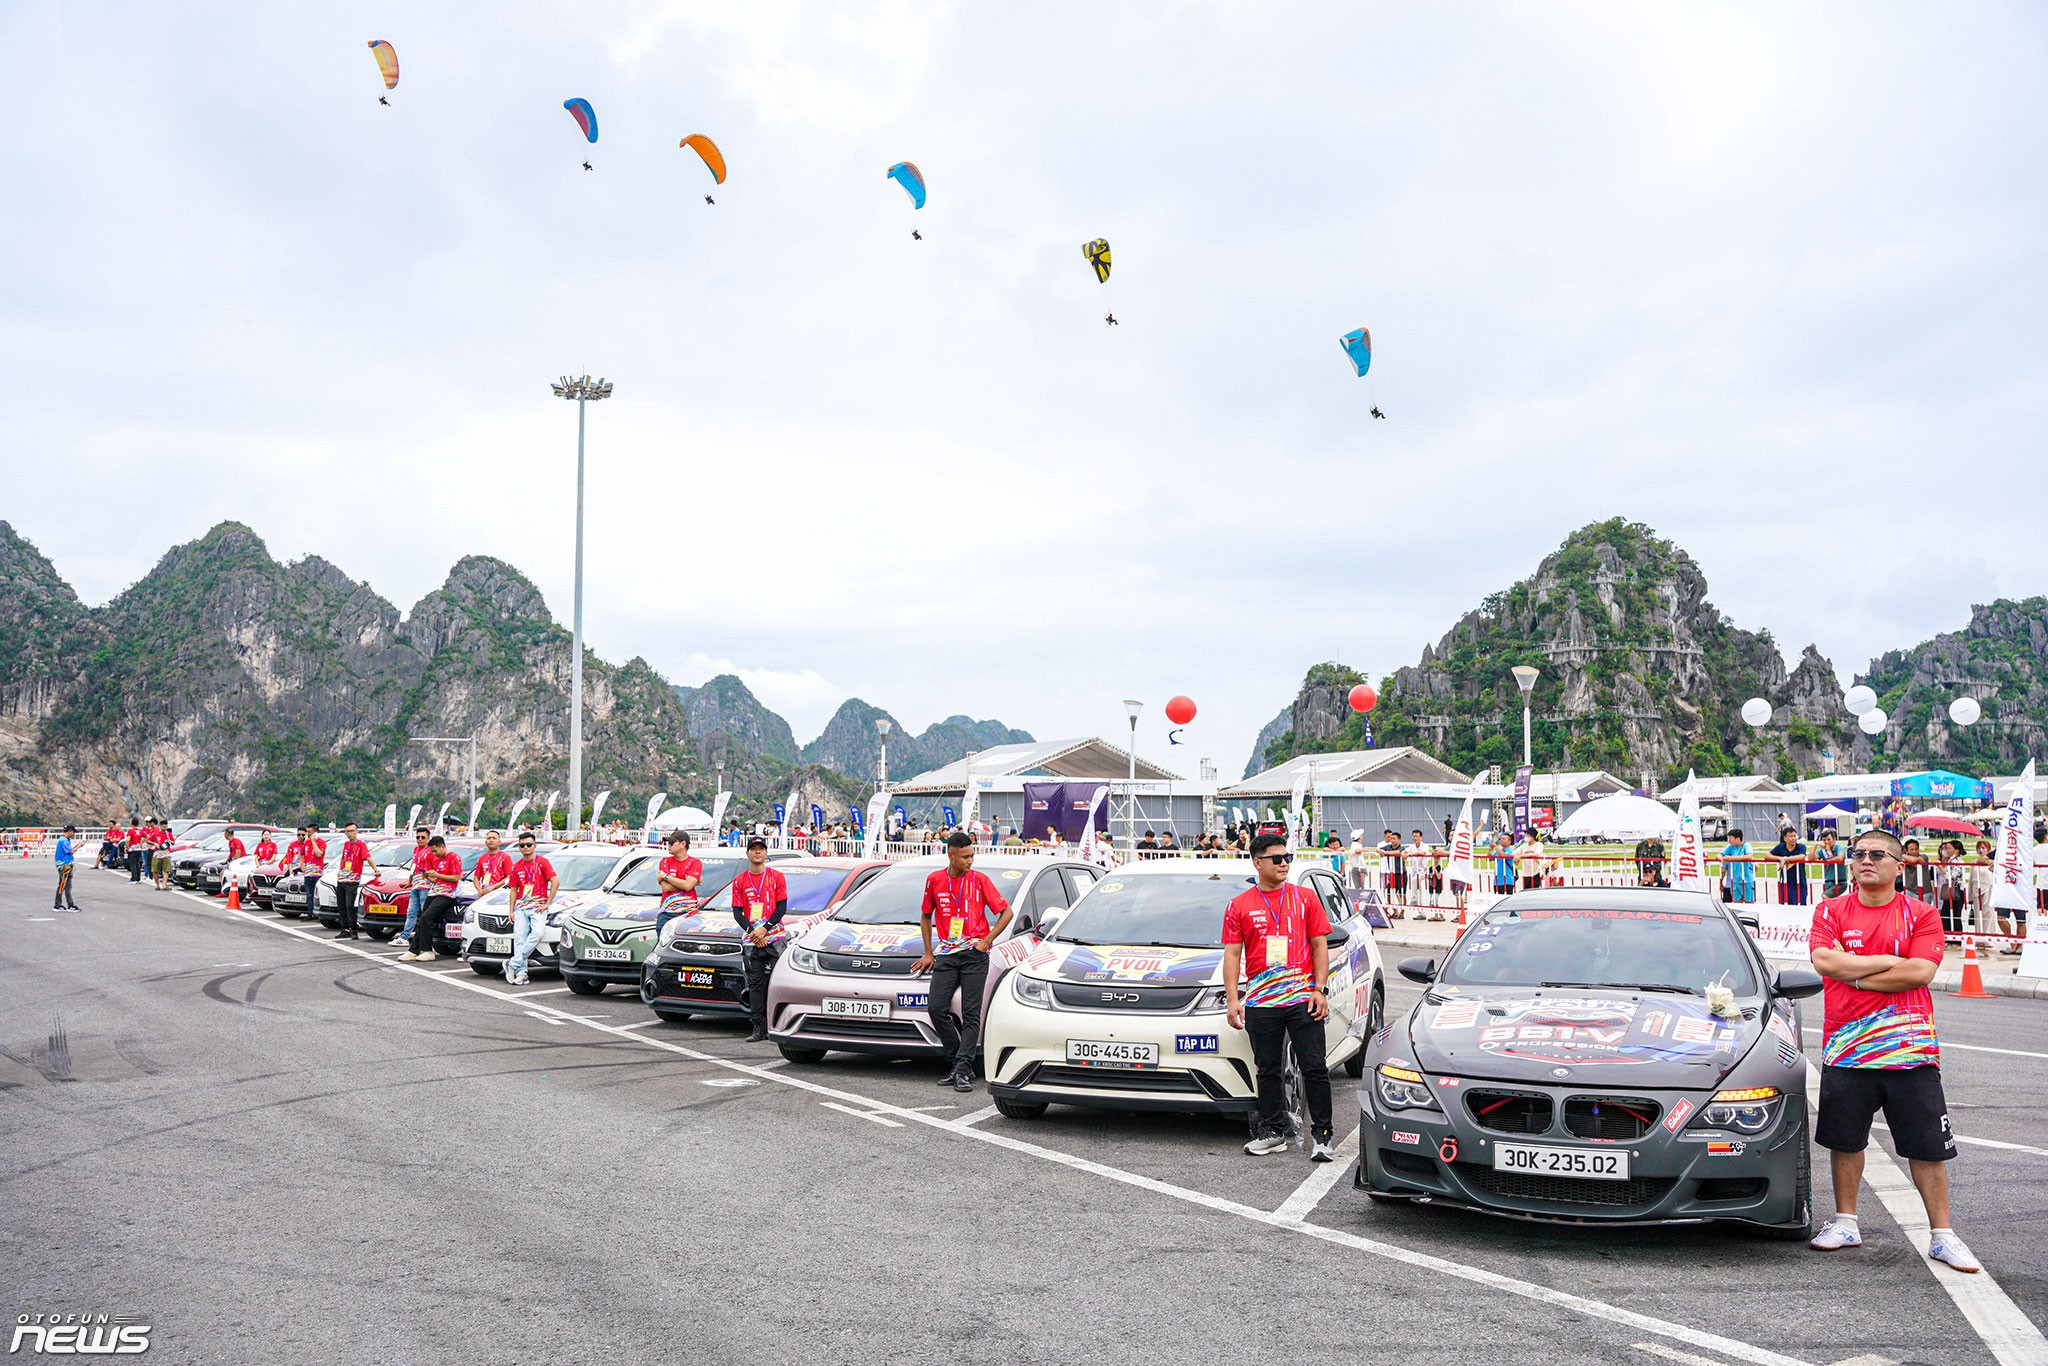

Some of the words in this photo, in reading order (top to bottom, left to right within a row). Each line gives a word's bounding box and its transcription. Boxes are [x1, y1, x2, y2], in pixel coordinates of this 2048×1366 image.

[1999, 797, 2023, 885] Ekokemika
[1679, 833, 1698, 881] PVOIL
[1606, 911, 1703, 925] GARAGE
[1477, 926, 1501, 935] 21
[858, 934, 901, 945] PVOIL
[588, 949, 627, 959] 51E-334.45
[998, 938, 1029, 966] PVOIL
[1467, 942, 1493, 952] 29
[852, 960, 880, 969] BYD
[1107, 958, 1162, 972] PVOIL
[898, 994, 914, 1007] TẬP
[915, 993, 928, 1005] LÁI
[1101, 992, 1139, 1002] BYD
[828, 1002, 884, 1014] 30B-170.67
[1177, 1036, 1198, 1052] TẬP
[1200, 1036, 1216, 1050] LÁI
[1074, 1043, 1150, 1060] 30G-445.62
[1505, 1149, 1617, 1174] 30K-235.02
